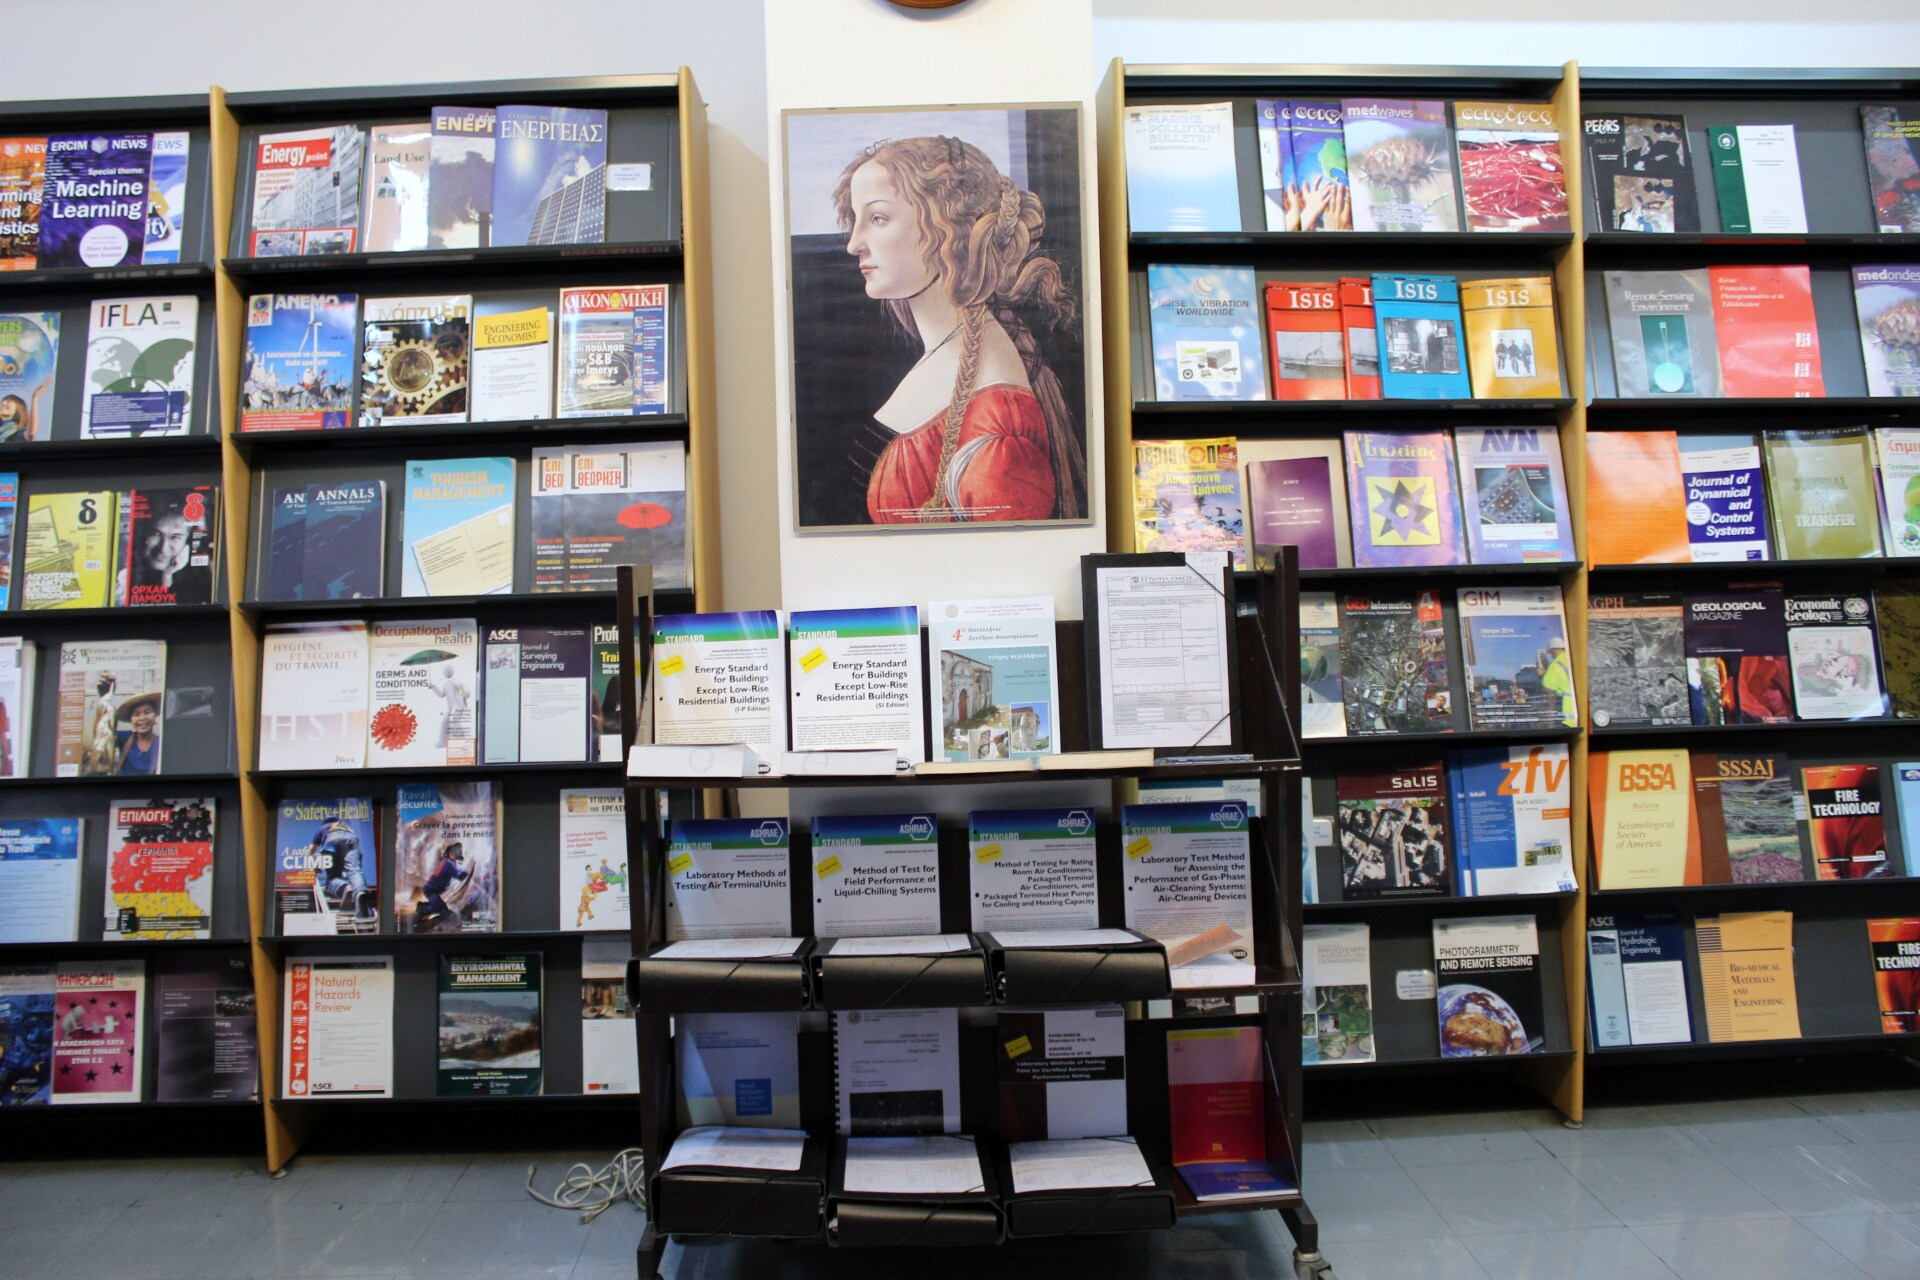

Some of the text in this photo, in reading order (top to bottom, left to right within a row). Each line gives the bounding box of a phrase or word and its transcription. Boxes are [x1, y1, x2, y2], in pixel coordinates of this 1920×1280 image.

[1347, 105, 1414, 119] medwaves
[500, 121, 603, 143] ΕΝΕΡΓΕΙΑΣ
[51, 141, 88, 151] ERCIM
[112, 138, 147, 151] NEWS
[262, 145, 328, 167] Energy point
[405, 153, 424, 163] Use
[56, 180, 143, 198] Machine
[52, 199, 142, 221] Learning
[99, 303, 158, 327] IFLA
[1176, 308, 1235, 316] WORLDWIDE
[484, 321, 541, 335] ENGINEERING
[487, 332, 537, 344] ECONOMIST
[1481, 429, 1539, 452] AVN
[1688, 473, 1750, 488] Journal of
[316, 488, 375, 500] ANNALS
[1689, 487, 1751, 502] Dynamical
[1729, 500, 1752, 510] and
[1710, 511, 1753, 524] Control
[1795, 514, 1856, 528] TRANSFER
[1707, 525, 1755, 538] Systems
[1463, 590, 1501, 606] GIM
[1371, 599, 1412, 610] Informatics
[1692, 602, 1766, 612] GEOLOGICAL
[1784, 599, 1841, 612] Economic
[1785, 610, 1832, 622] Geology
[375, 625, 451, 639] Occupational
[489, 630, 518, 640] ASCE
[434, 632, 472, 645] health
[665, 635, 704, 644] STANDARD
[522, 652, 557, 661] Surveying
[275, 661, 340, 671] DU TRAVAIL
[522, 662, 564, 671] Engineering
[695, 664, 768, 675] Energy Standard
[833, 660, 907, 671] Energy Standard
[376, 670, 406, 678] GERMS
[867, 671, 907, 679] Buildings
[375, 680, 428, 689] CONDITIONS
[730, 676, 769, 684] Buildings
[697, 685, 769, 695] Except Low-Rise
[835, 681, 908, 691] Except Low-Rise
[730, 696, 769, 705] Buildings
[817, 693, 908, 702] Residential Buildings
[1497, 748, 1569, 796] zfv
[1718, 759, 1774, 780] SSSAJ
[1392, 775, 1438, 789] SaLIS
[1619, 764, 1676, 792] BSSA
[1835, 790, 1860, 802] FIRE
[1813, 802, 1880, 816] TECHNOLOGY
[119, 811, 170, 823] ΕΠΙΛΟΓΗ
[1210, 812, 1239, 822] ASHRAE
[900, 824, 928, 834] ASHRAE
[1058, 819, 1086, 828] ASHRAE
[441, 831, 460, 839] dans
[750, 829, 778, 838] ASHRAE
[1617, 830, 1647, 840] Society
[283, 855, 333, 870] CLIMB
[1032, 860, 1057, 868] Testing
[1071, 859, 1093, 867] Rating
[1141, 856, 1188, 865] Laboratory
[1212, 853, 1245, 861] Method
[853, 866, 887, 875] Method
[890, 865, 898, 874] of
[901, 865, 920, 873] Test
[1189, 864, 1229, 873] Assessing
[1231, 863, 1245, 871] the
[686, 872, 734, 880] Laboratory
[737, 870, 775, 878] Methods
[844, 875, 936, 886] Field Performance of
[1134, 875, 1189, 884] Performance
[1202, 873, 1246, 882] Gas-Phase
[675, 882, 707, 891] Testing
[723, 881, 762, 889] Terminal
[763, 880, 786, 888] Units
[1153, 883, 1246, 893] Air-Cleaning Systems:
[834, 886, 936, 898] Liquid-Chilling Systems
[1158, 893, 1247, 903] Air-Cleaning Devices
[1588, 917, 1615, 927] ASCE
[1620, 936, 1657, 946] Hydrologic
[1439, 945, 1519, 957] PHOTOGRAMMETRY
[451, 963, 526, 972] ENVIRONMENTAL
[1440, 956, 1533, 970] AND REMOTE SENSING
[315, 975, 357, 987] Natural
[315, 988, 360, 999] Hazards
[315, 1002, 352, 1012] Review
